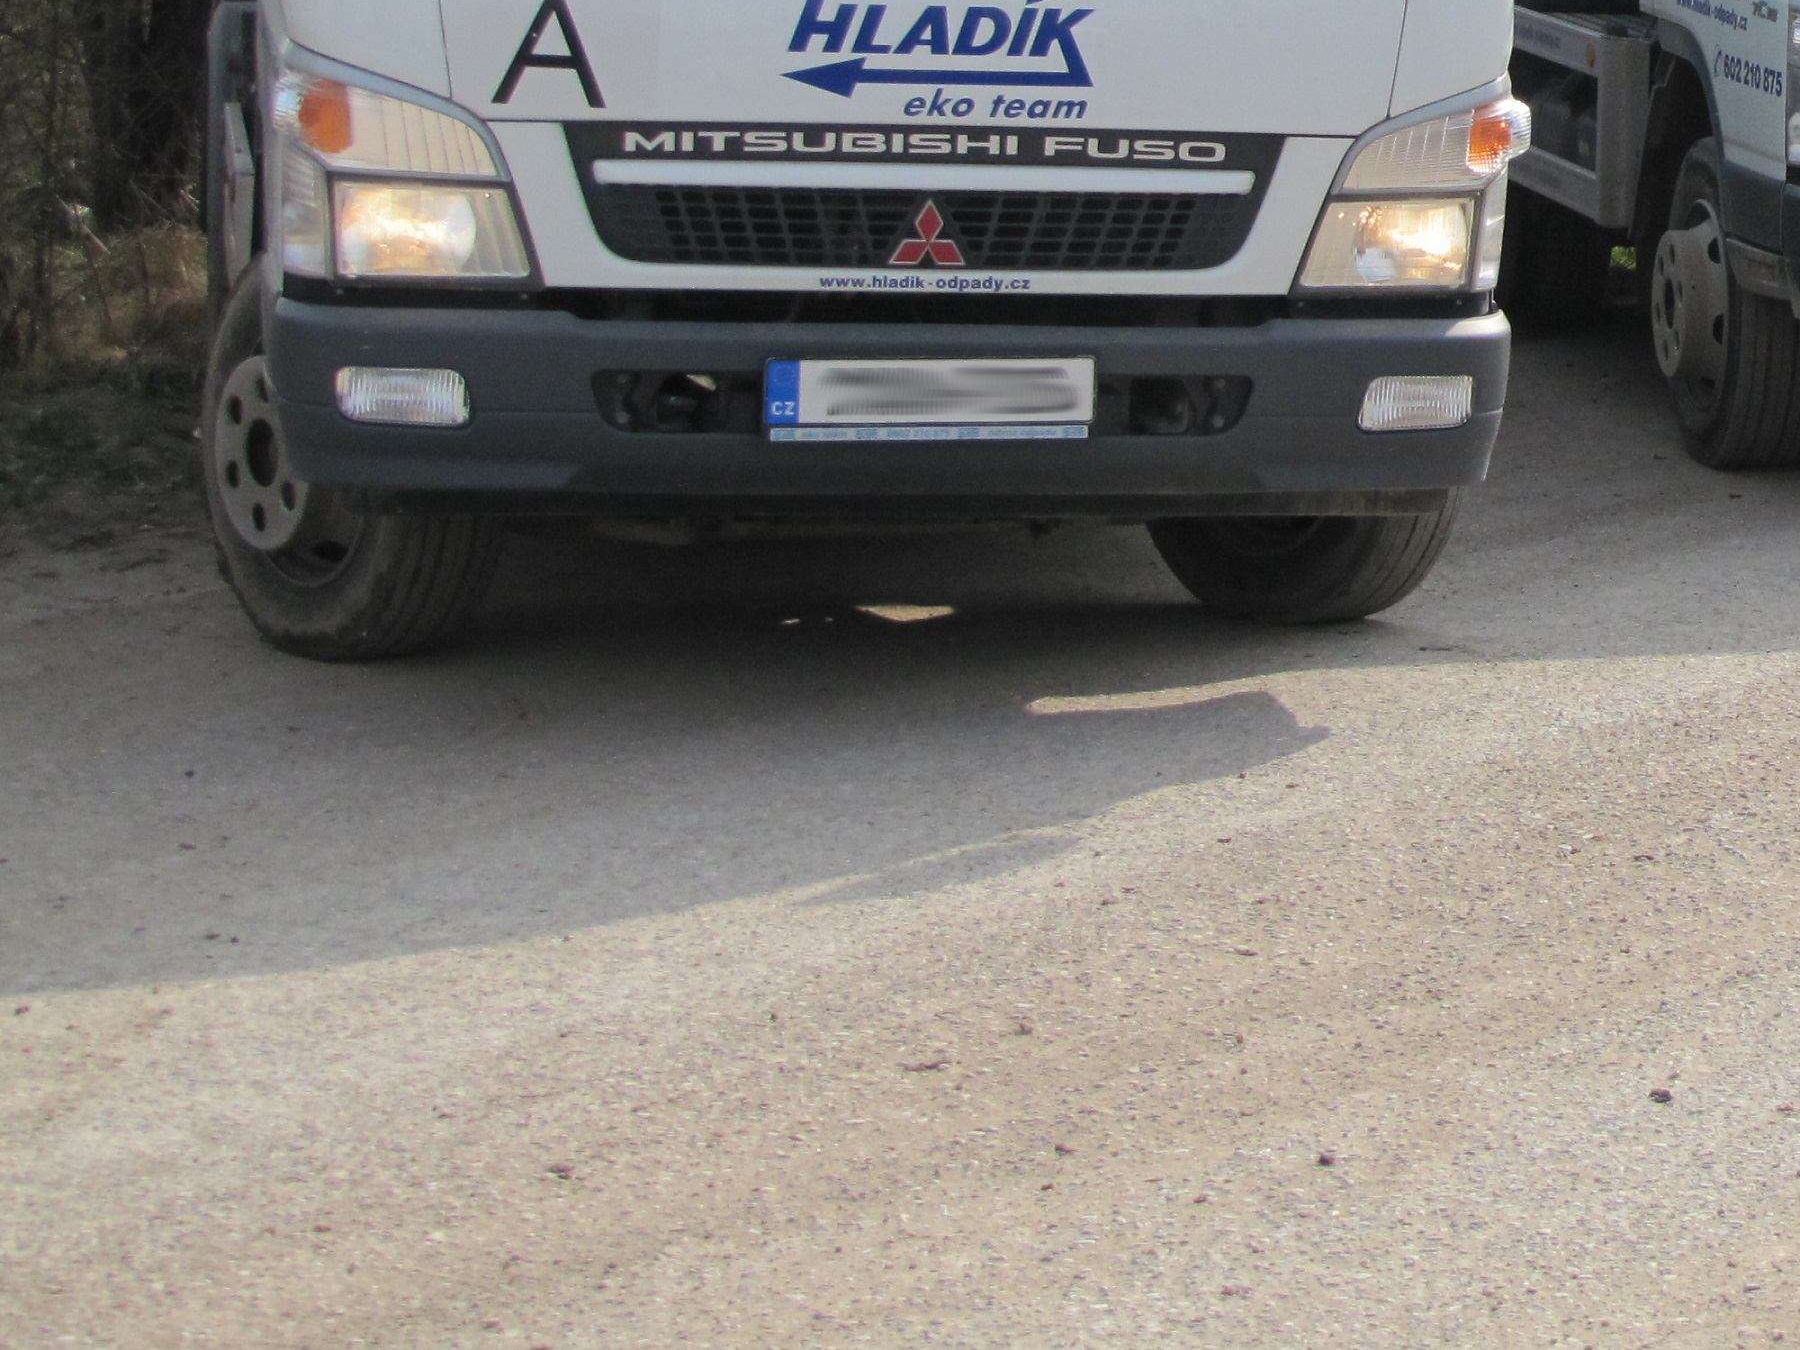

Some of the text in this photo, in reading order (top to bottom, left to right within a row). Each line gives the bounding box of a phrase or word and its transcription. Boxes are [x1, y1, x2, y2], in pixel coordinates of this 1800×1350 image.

[1723, 54, 1782, 97] 602 210 875
[903, 87, 1089, 120] eko team
[622, 130, 1227, 163] MITSUBISHI FUSO
[819, 273, 1031, 294] www.hladik-odpady.cz
[771, 401, 796, 416] CZ
